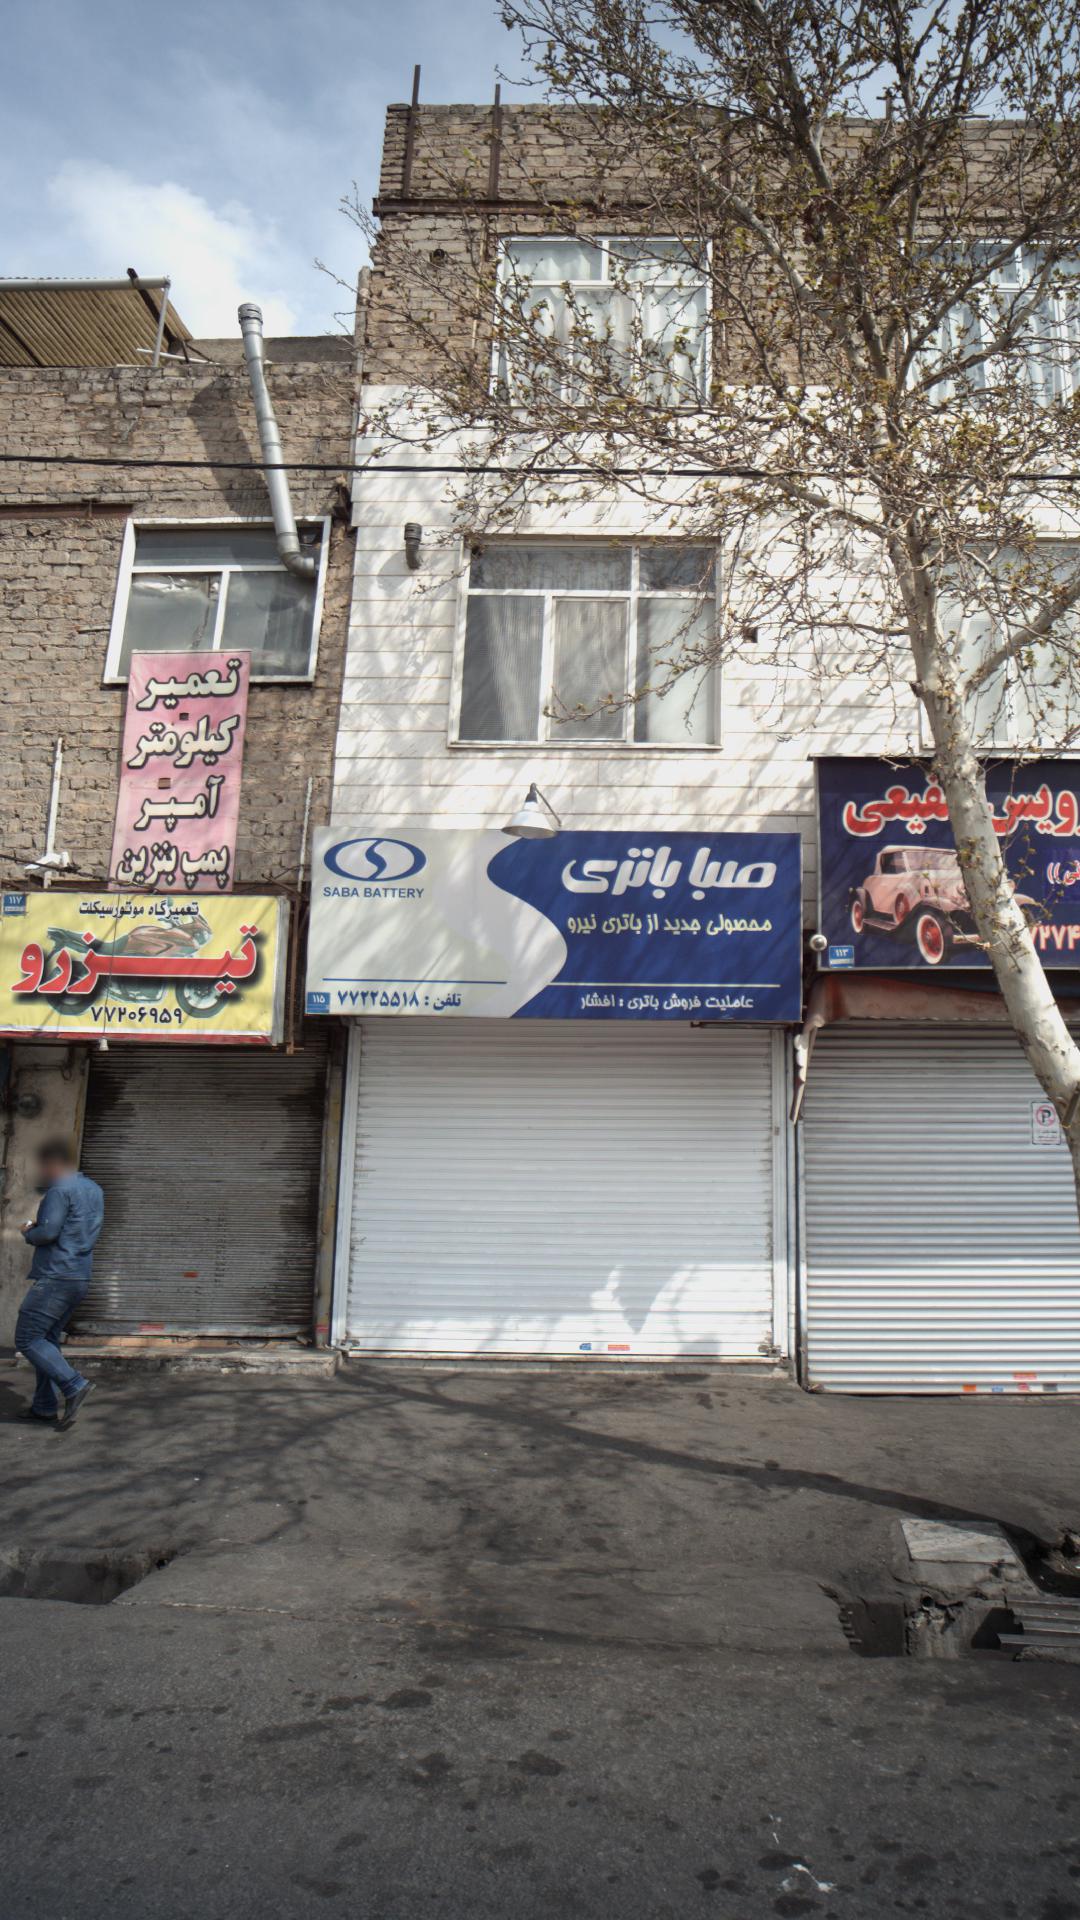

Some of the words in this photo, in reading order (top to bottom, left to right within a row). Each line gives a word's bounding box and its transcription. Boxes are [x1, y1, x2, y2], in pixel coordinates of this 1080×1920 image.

[137, 658, 242, 711] تعمیر
[127, 715, 241, 769] کیلومتر
[134, 775, 224, 831] آمپر
[181, 845, 230, 889] پمپ
[561, 846, 682, 900] باتری
[689, 847, 776, 901] صبا
[323, 887, 359, 898] SABA
[364, 887, 424, 899] BATTERY
[79, 900, 144, 918] موتورسیکلت
[148, 900, 199, 919] تعمیرگاه
[567, 913, 597, 935] نیرو
[602, 913, 642, 935] باتری
[647, 913, 659, 935] از
[663, 918, 702, 935] جدید
[706, 914, 772, 936] محصولی
[11, 924, 260, 994] تیزرو
[433, 992, 462, 1011] تلفن
[580, 992, 615, 1010] افشار
[627, 994, 659, 1010] باتری
[663, 993, 701, 1010] فروش
[705, 995, 754, 1011] عاملیت
[91, 1006, 182, 1024] ۷۷۲۰۶۹۵۹
